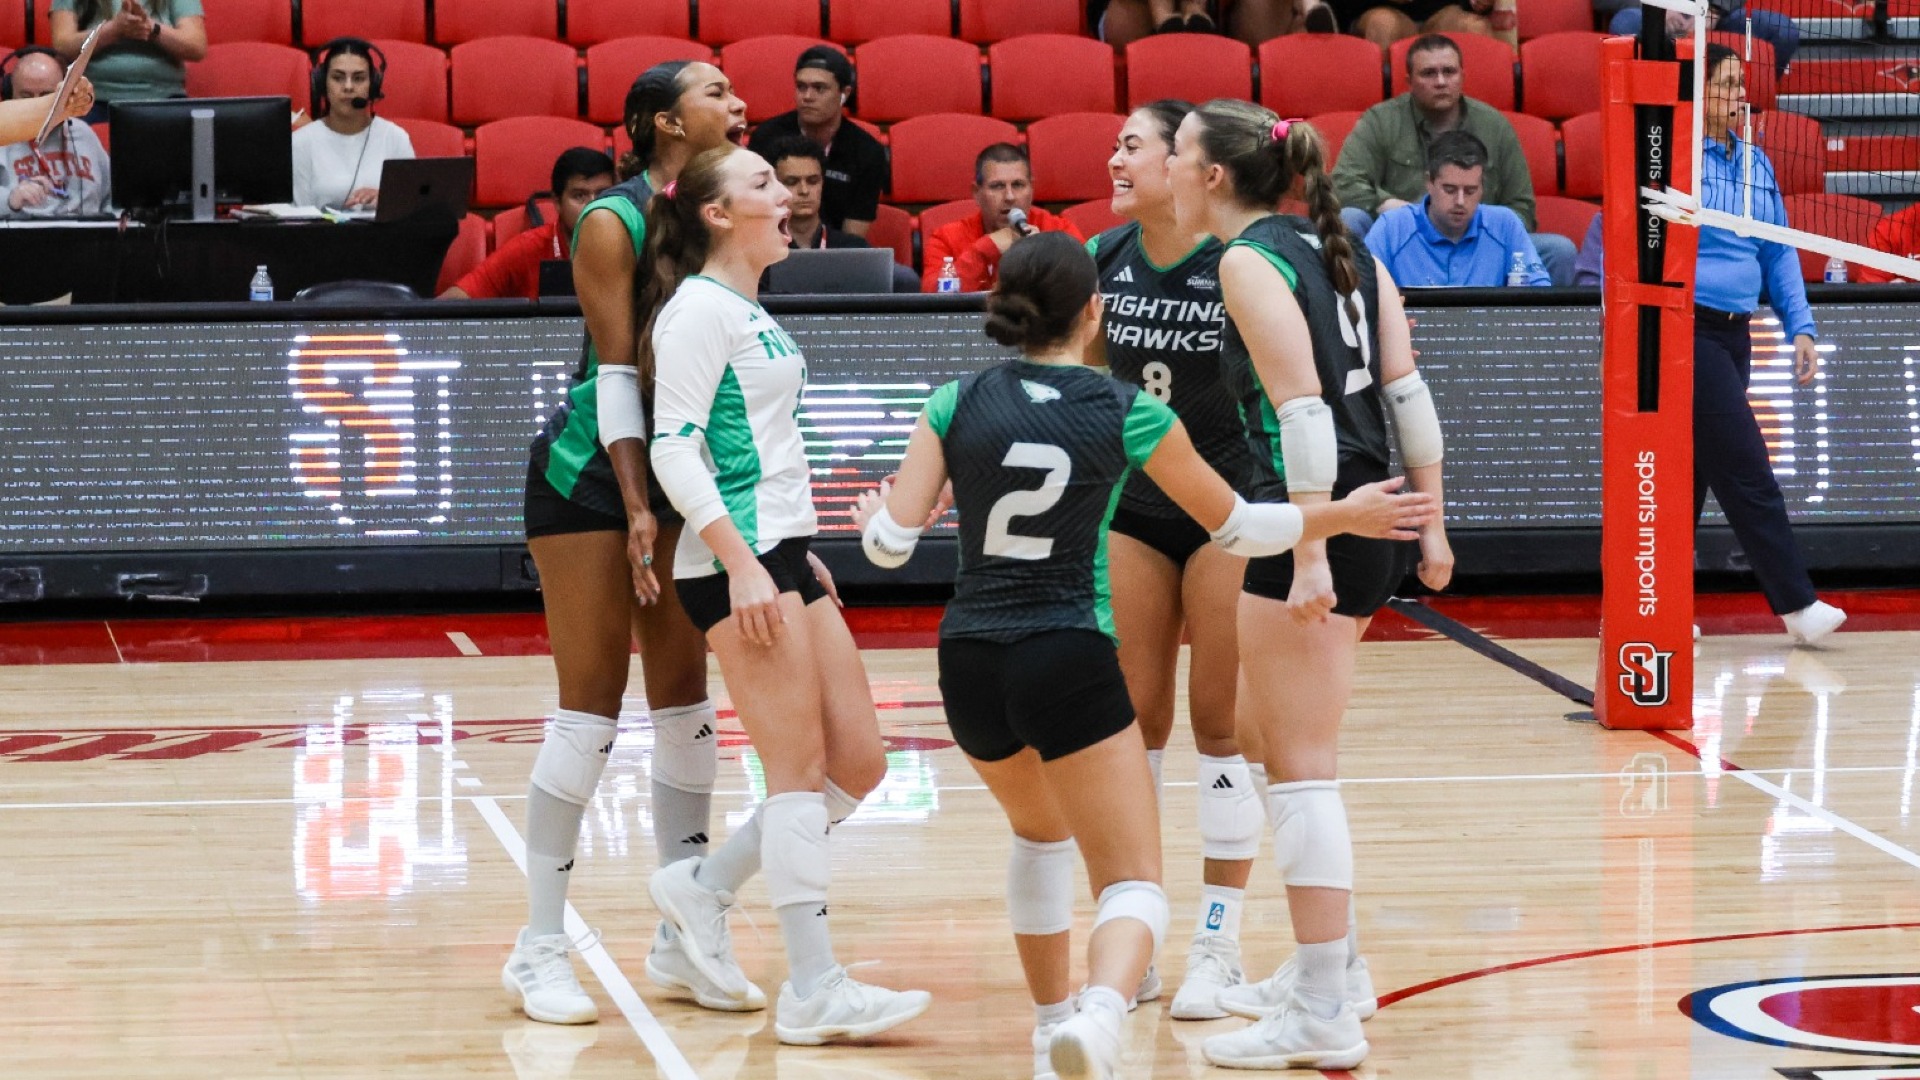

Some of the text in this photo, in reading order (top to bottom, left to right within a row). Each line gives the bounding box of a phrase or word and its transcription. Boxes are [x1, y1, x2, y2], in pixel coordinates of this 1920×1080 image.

[1648, 126, 1662, 180] sports
[1107, 321, 1220, 352] HAWKS
[1335, 288, 1373, 396] 9
[1142, 361, 1172, 405] 8
[983, 441, 1072, 560] 2
[1634, 451, 1658, 617] sports imports
[1619, 642, 1676, 707] SU
